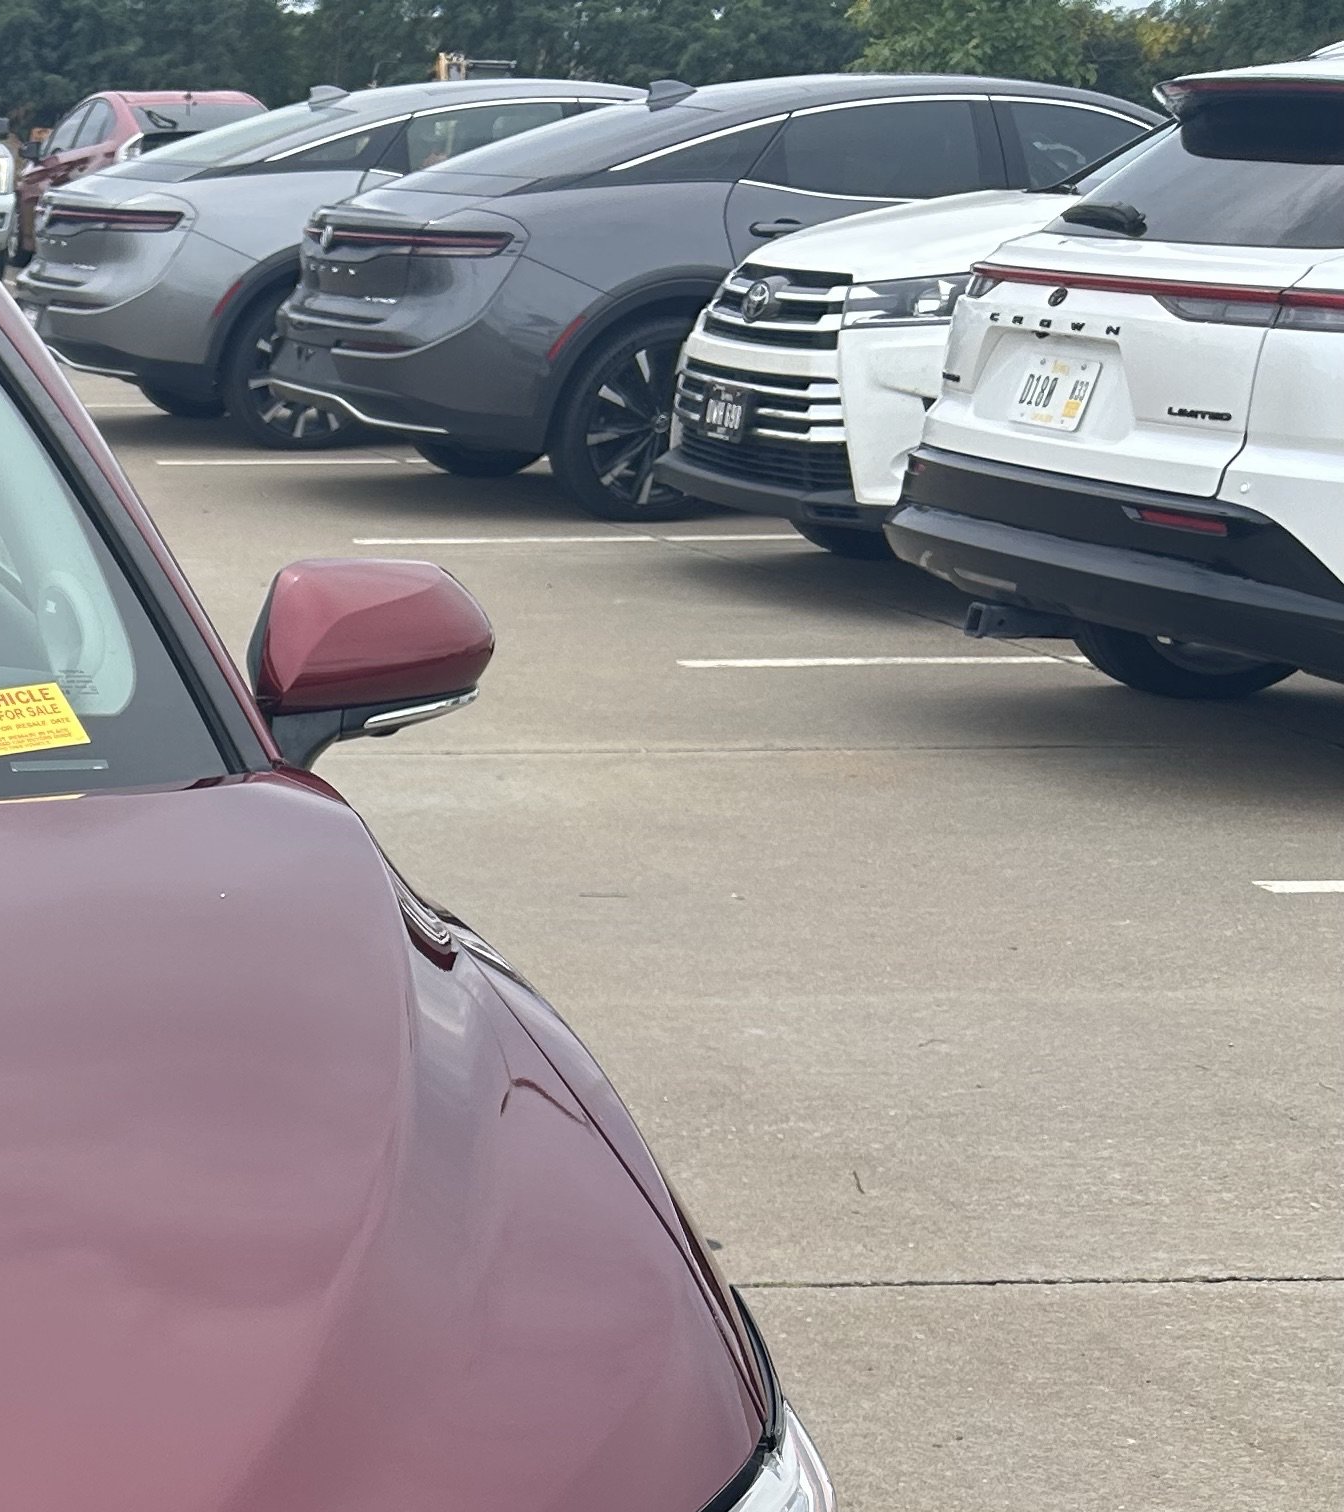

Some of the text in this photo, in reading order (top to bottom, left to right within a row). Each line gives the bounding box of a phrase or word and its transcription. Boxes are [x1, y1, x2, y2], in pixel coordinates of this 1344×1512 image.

[989, 312, 1120, 336] CROWN
[1167, 406, 1232, 422] LIMITED
[24, 702, 62, 717] SALE
[49, 716, 71, 724] DATE
